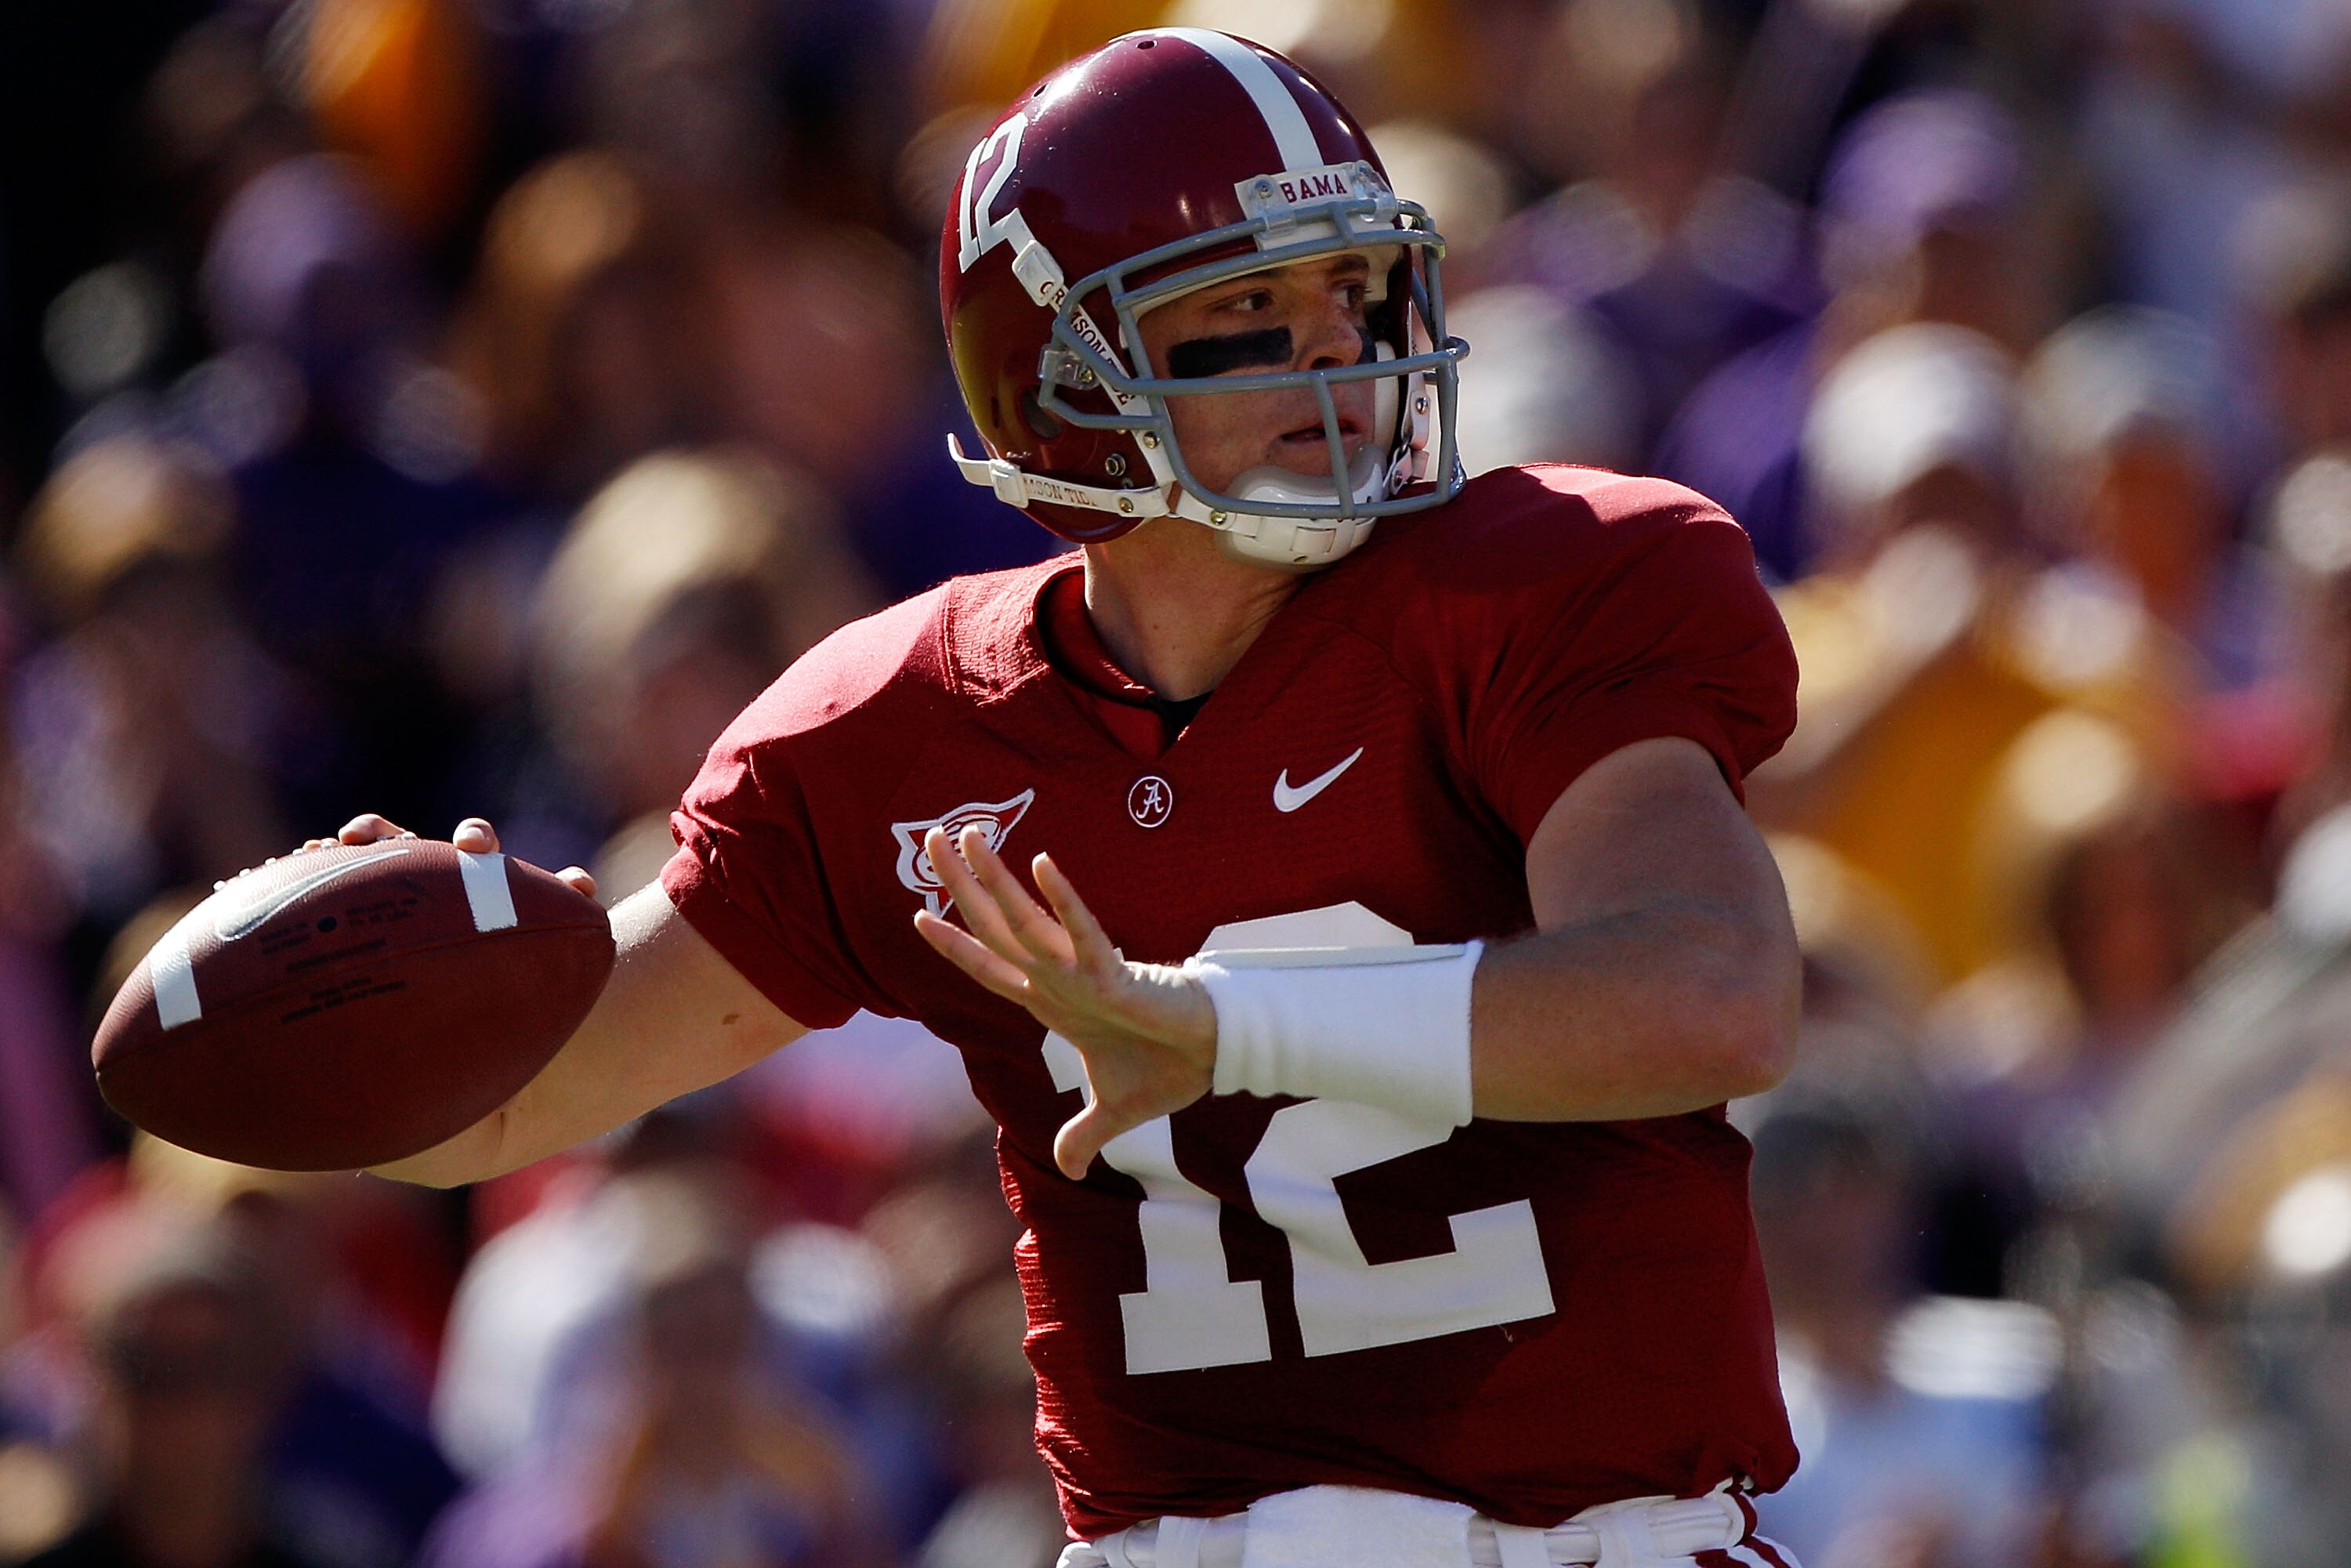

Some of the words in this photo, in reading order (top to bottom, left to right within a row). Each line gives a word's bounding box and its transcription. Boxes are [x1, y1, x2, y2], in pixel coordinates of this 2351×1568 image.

[958, 112, 1028, 273] 12
[1279, 173, 1347, 204] BAMA
[1064, 487, 1097, 506] TID
[1136, 781, 1165, 819] A
[1041, 900, 1556, 1375] 12
